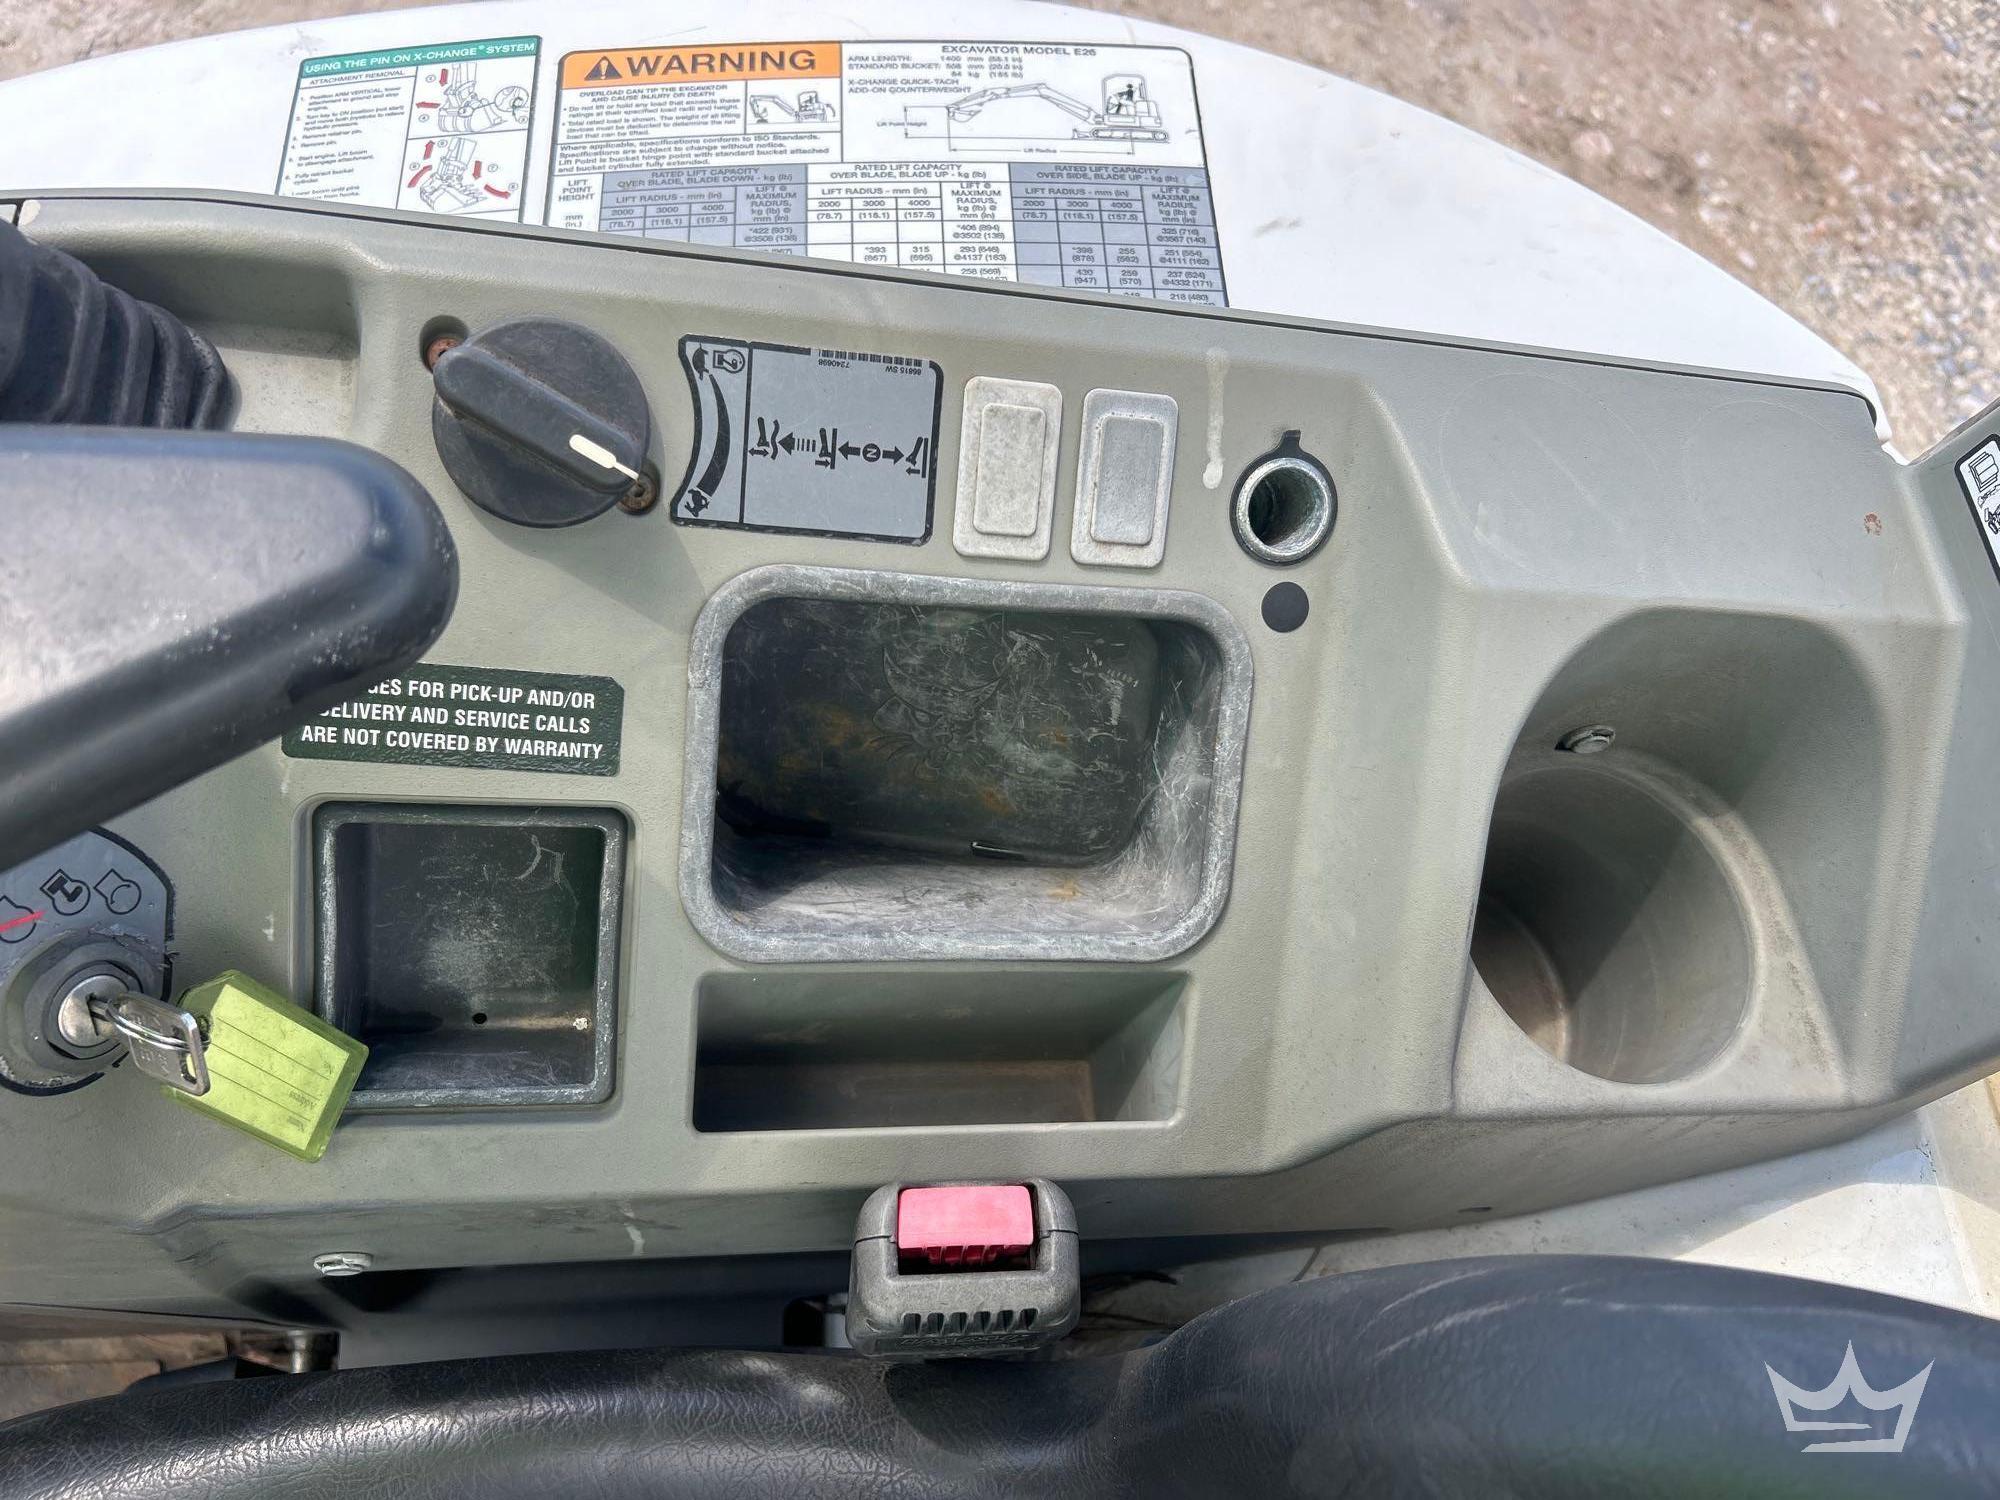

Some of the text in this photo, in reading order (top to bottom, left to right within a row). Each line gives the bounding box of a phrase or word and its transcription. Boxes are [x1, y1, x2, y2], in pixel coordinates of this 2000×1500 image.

[941, 45, 1097, 56] EXCAVATOR MODEL E26
[305, 63, 340, 73] USING
[345, 59, 367, 68] THE
[370, 56, 390, 65] PIN
[393, 54, 411, 63] ON
[486, 42, 535, 54] SYSTEM
[626, 50, 816, 77] WARNING
[310, 70, 405, 85] ATTACHMENT REMOVAL
[579, 89, 624, 97] OVERLOAD
[678, 84, 728, 92] EXCAVATOR
[848, 86, 971, 94] ADD-ON COUNTERWEIGHT
[639, 139, 700, 147] specifications
[560, 150, 620, 159] Specifications
[639, 146, 671, 154] subject
[685, 144, 718, 152] change
[608, 162, 642, 170] cylinder
[1089, 165, 1109, 173] LIFT
[1111, 166, 1160, 175] CAPACITY
[687, 169, 707, 177] LIFT
[710, 167, 759, 176] CAPACITY
[830, 171, 858, 179] OVER
[957, 171, 970, 179] kg
[972, 171, 987, 179] (lb)
[1036, 171, 1064, 179] OVER
[1066, 172, 1092, 180] SIDE,
[1093, 172, 1125, 180] BLADE
[568, 179, 588, 187] LIFT
[617, 180, 645, 188] OVER
[647, 178, 684, 186] BLADE,
[686, 176, 720, 184] BLADE
[763, 174, 776, 182] kg
[562, 186, 592, 194] POINT
[845, 187, 883, 195] RADIUS
[913, 187, 928, 195] (in)
[558, 193, 595, 201] HEIGHT
[616, 196, 637, 204] LIFT
[640, 194, 678, 202] RADIUS
[708, 192, 722, 200] (in)
[746, 192, 797, 200] MAXIMUM
[818, 200, 841, 208] 2000
[816, 212, 843, 220] (78.7)
[981, 212, 995, 220] (in)
[885, 365, 898, 373] SW
[408, 680, 444, 699] FOR
[450, 683, 523, 704] PICK-UP
[527, 689, 595, 709] AND/OR
[410, 706, 449, 725] AND
[454, 709, 530, 730] SERVICE
[535, 715, 591, 735] CALLS
[301, 725, 603, 760] ARE NOT COVERED BY WARRANTY
